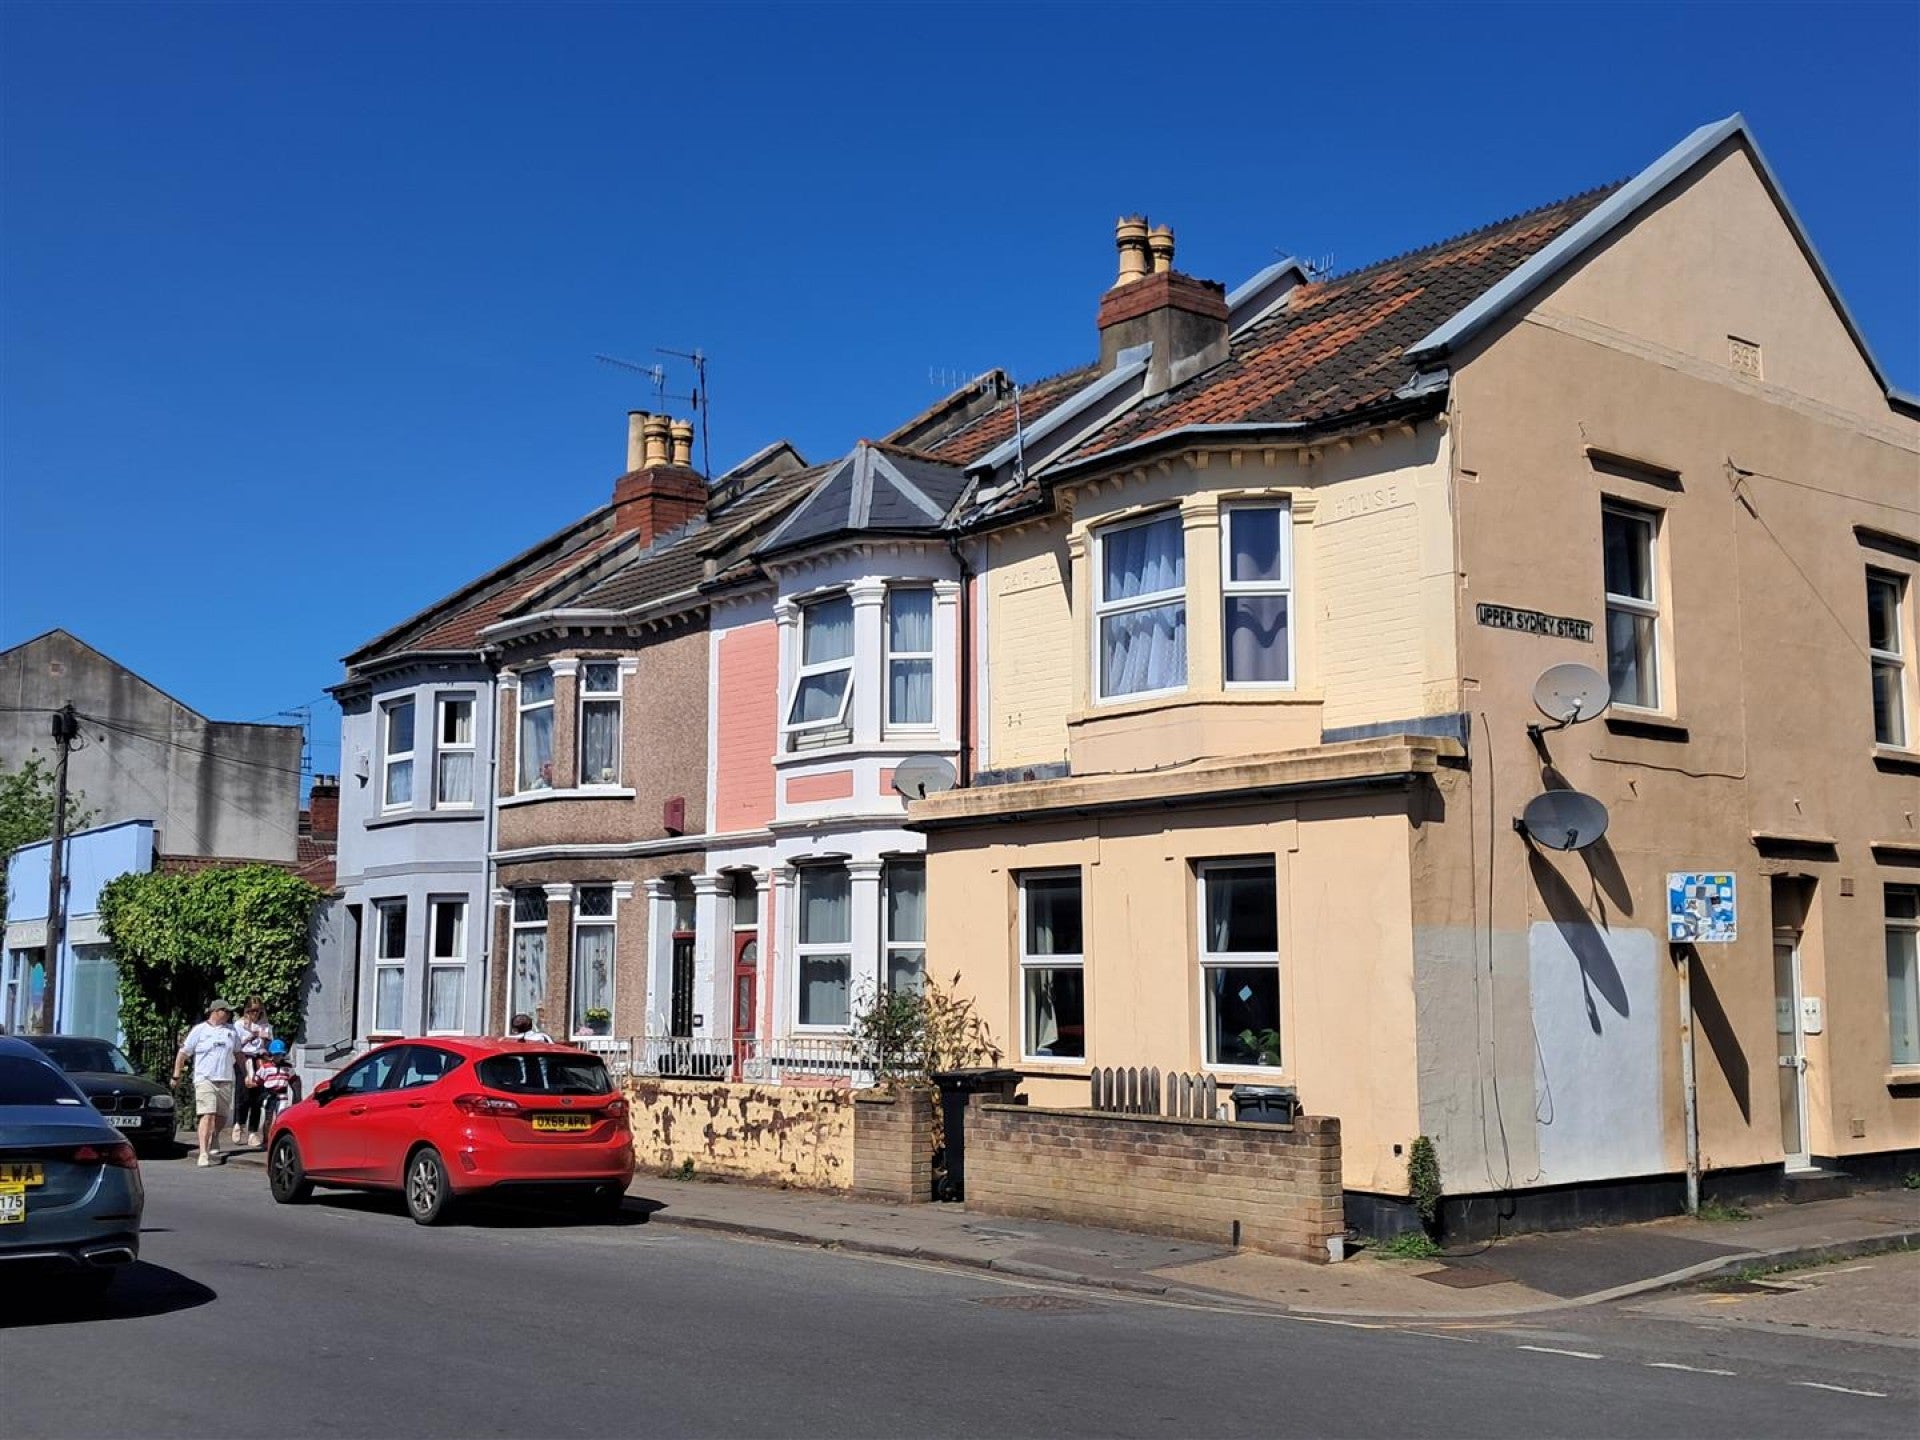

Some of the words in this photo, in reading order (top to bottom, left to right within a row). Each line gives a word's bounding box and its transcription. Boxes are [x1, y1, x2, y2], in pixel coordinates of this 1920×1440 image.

[1334, 486, 1398, 515] HOUSE
[1480, 607, 1513, 627] UPPER
[1517, 612, 1554, 635] SYDNEY
[1556, 620, 1591, 641] STREET
